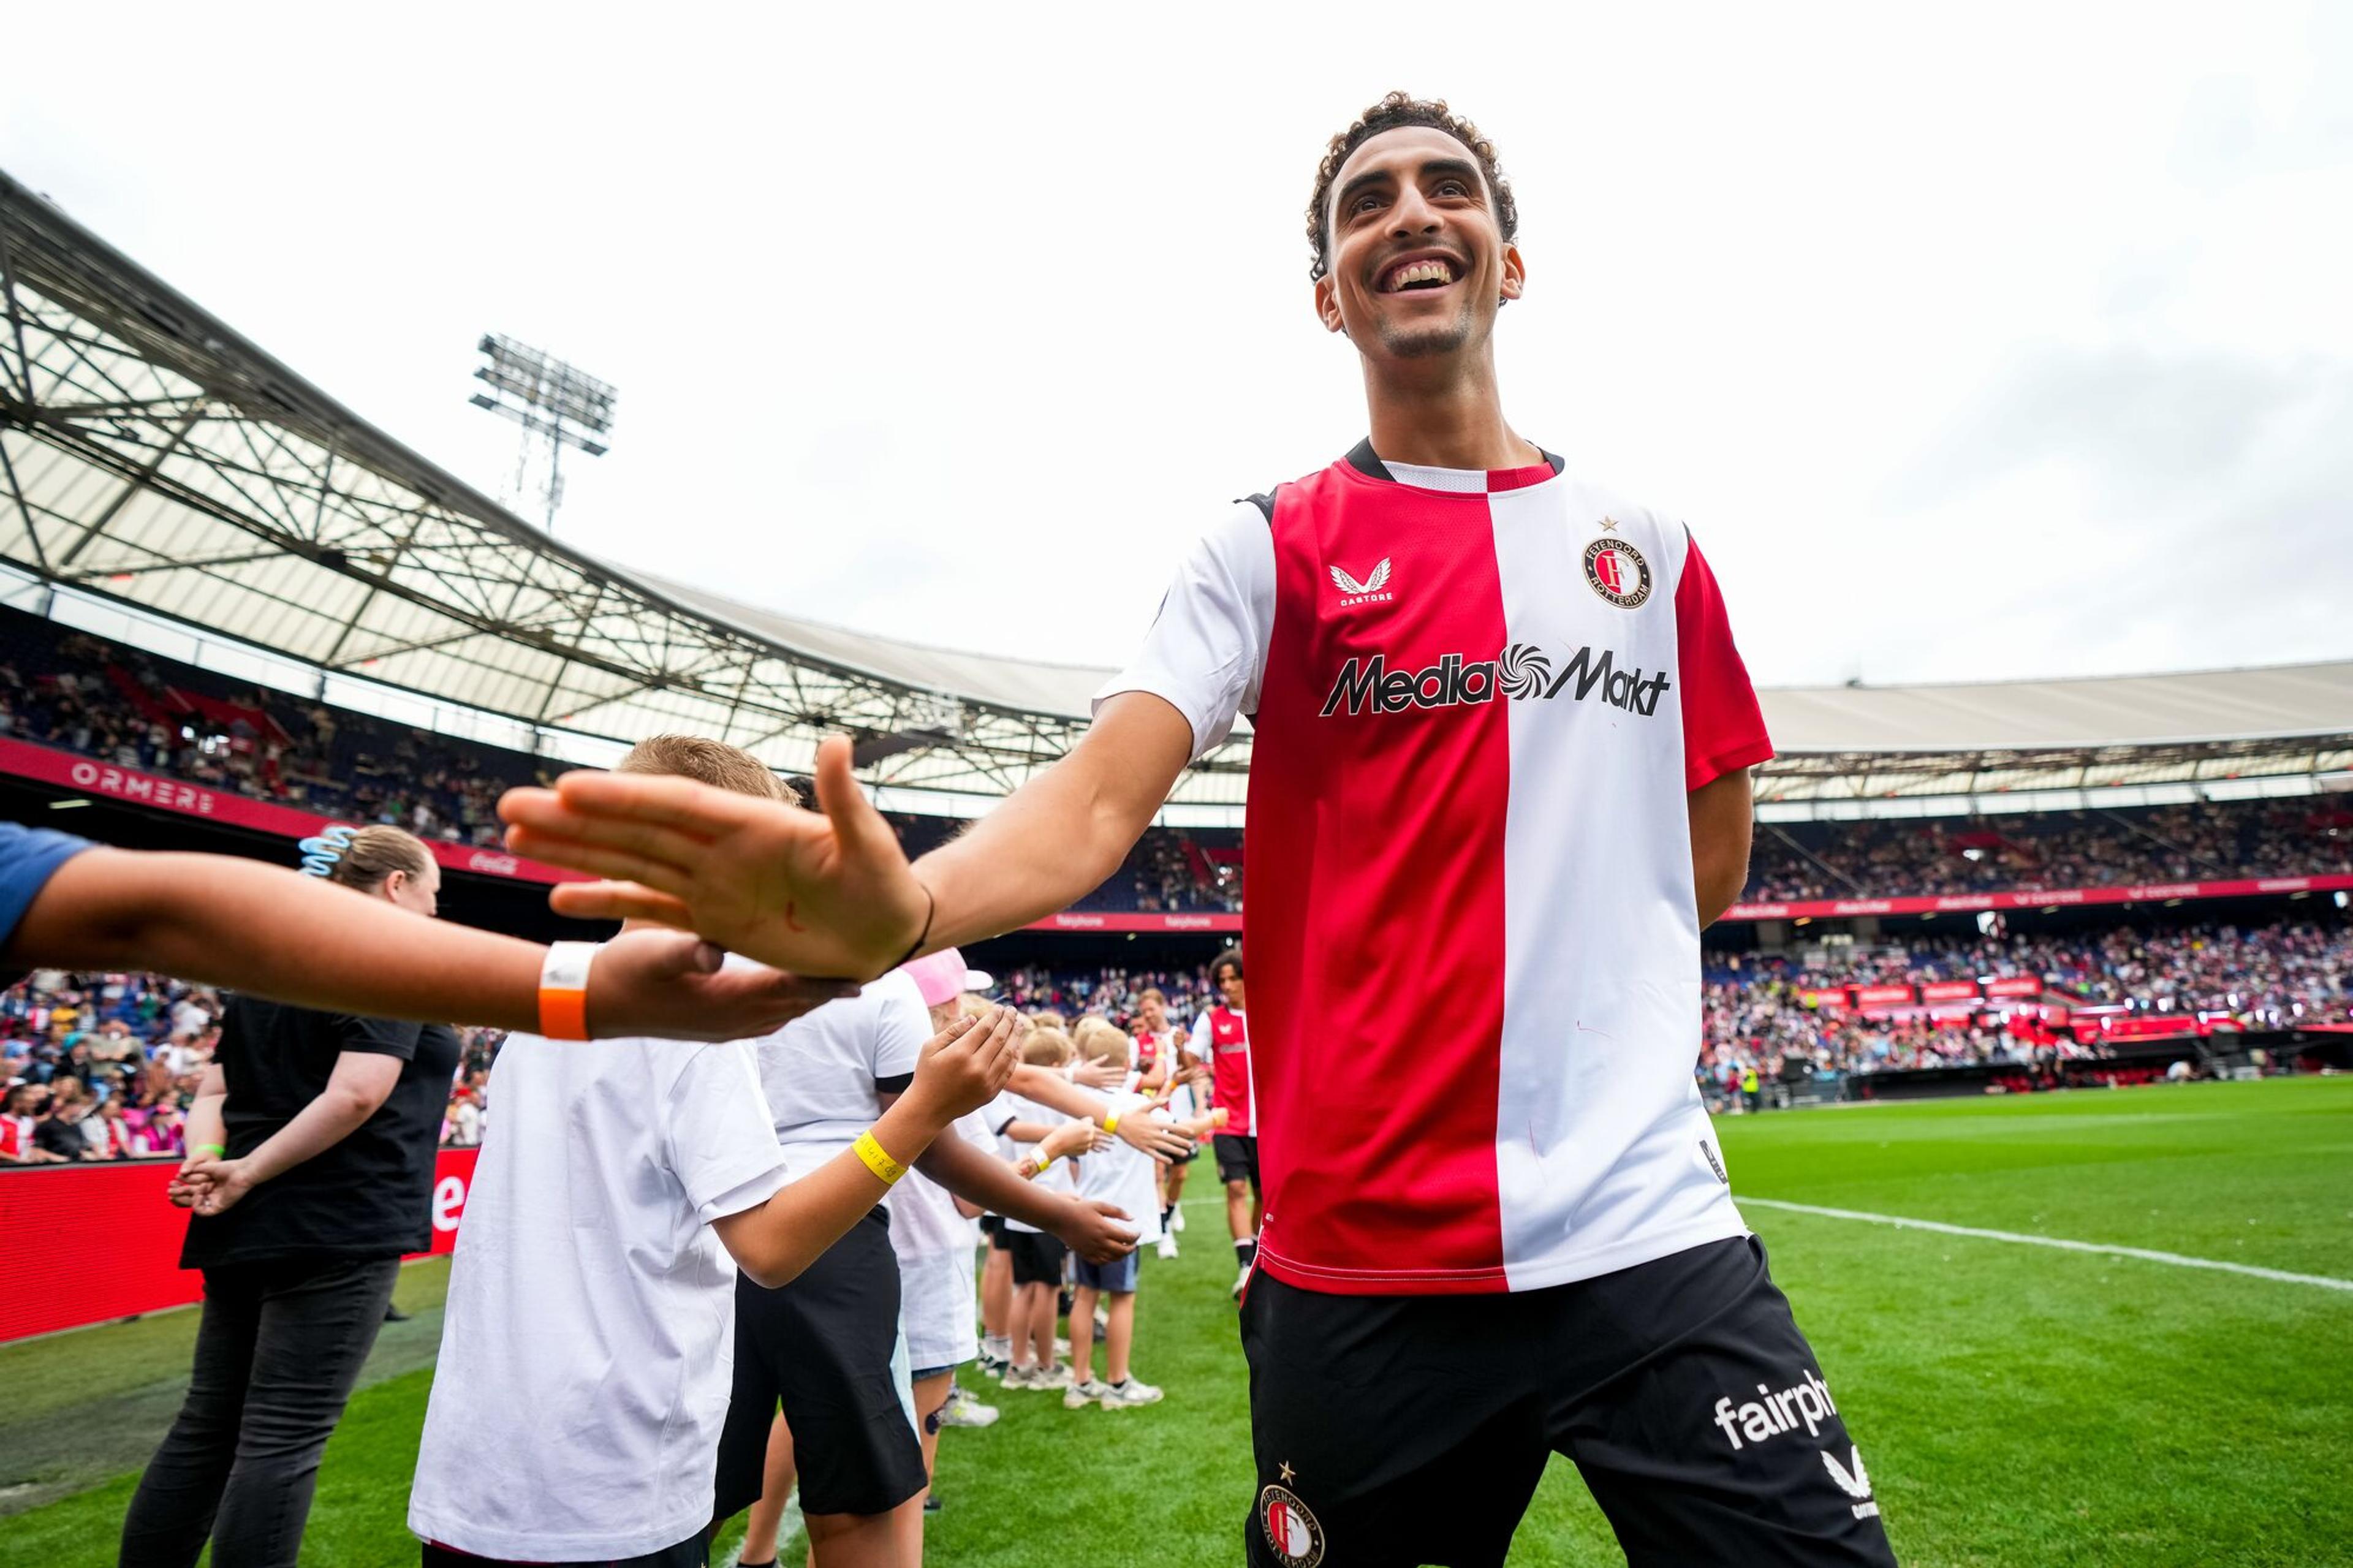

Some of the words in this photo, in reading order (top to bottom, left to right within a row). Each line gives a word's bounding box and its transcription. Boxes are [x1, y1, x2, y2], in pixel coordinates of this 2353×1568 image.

[1586, 540, 1644, 566] FEYENOORD
[1341, 593, 1393, 606] CASTORE
[1591, 576, 1650, 605] ROTTERDAM
[1319, 654, 1496, 716] Media
[1544, 646, 1670, 716] Markt
